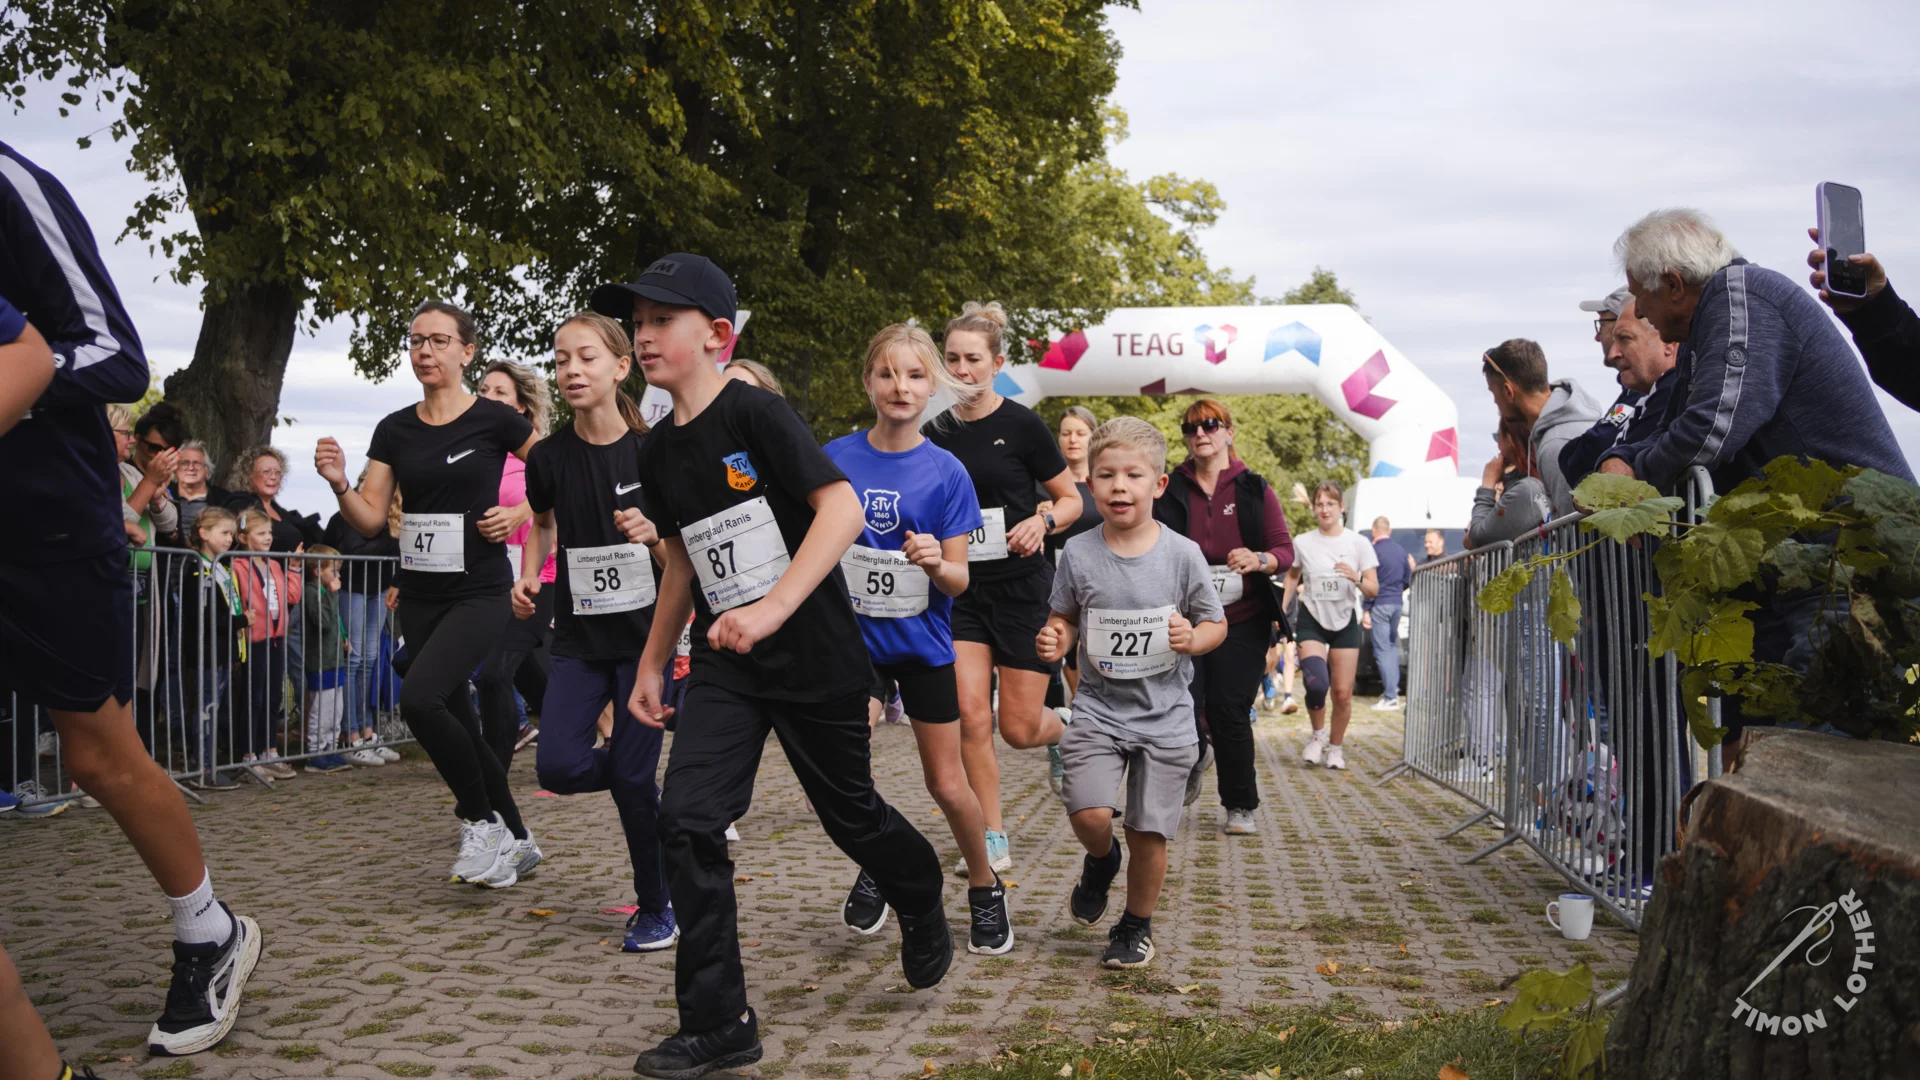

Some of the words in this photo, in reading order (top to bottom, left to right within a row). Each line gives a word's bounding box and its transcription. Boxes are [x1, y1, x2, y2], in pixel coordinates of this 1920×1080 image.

[1112, 332, 1184, 356] TEAG
[730, 457, 748, 473] STV
[734, 477, 756, 488] RANIS
[871, 496, 892, 511] STV
[874, 511, 890, 519] 1860
[684, 522, 724, 547] Limberglauf
[725, 513, 752, 531] Ranis
[870, 519, 893, 529] RANIS
[414, 532, 435, 552] 47
[577, 553, 613, 564] Limberglauf
[614, 551, 635, 560] Ranis
[707, 540, 736, 579] 87
[852, 552, 892, 566] Limberglauf
[593, 567, 621, 592] 58
[771, 574, 780, 583] eG
[866, 571, 895, 595] 59
[1321, 581, 1339, 592] 193
[1099, 616, 1141, 627] Limberglauf
[1143, 615, 1164, 625] Ranis
[1110, 631, 1153, 656] 227
